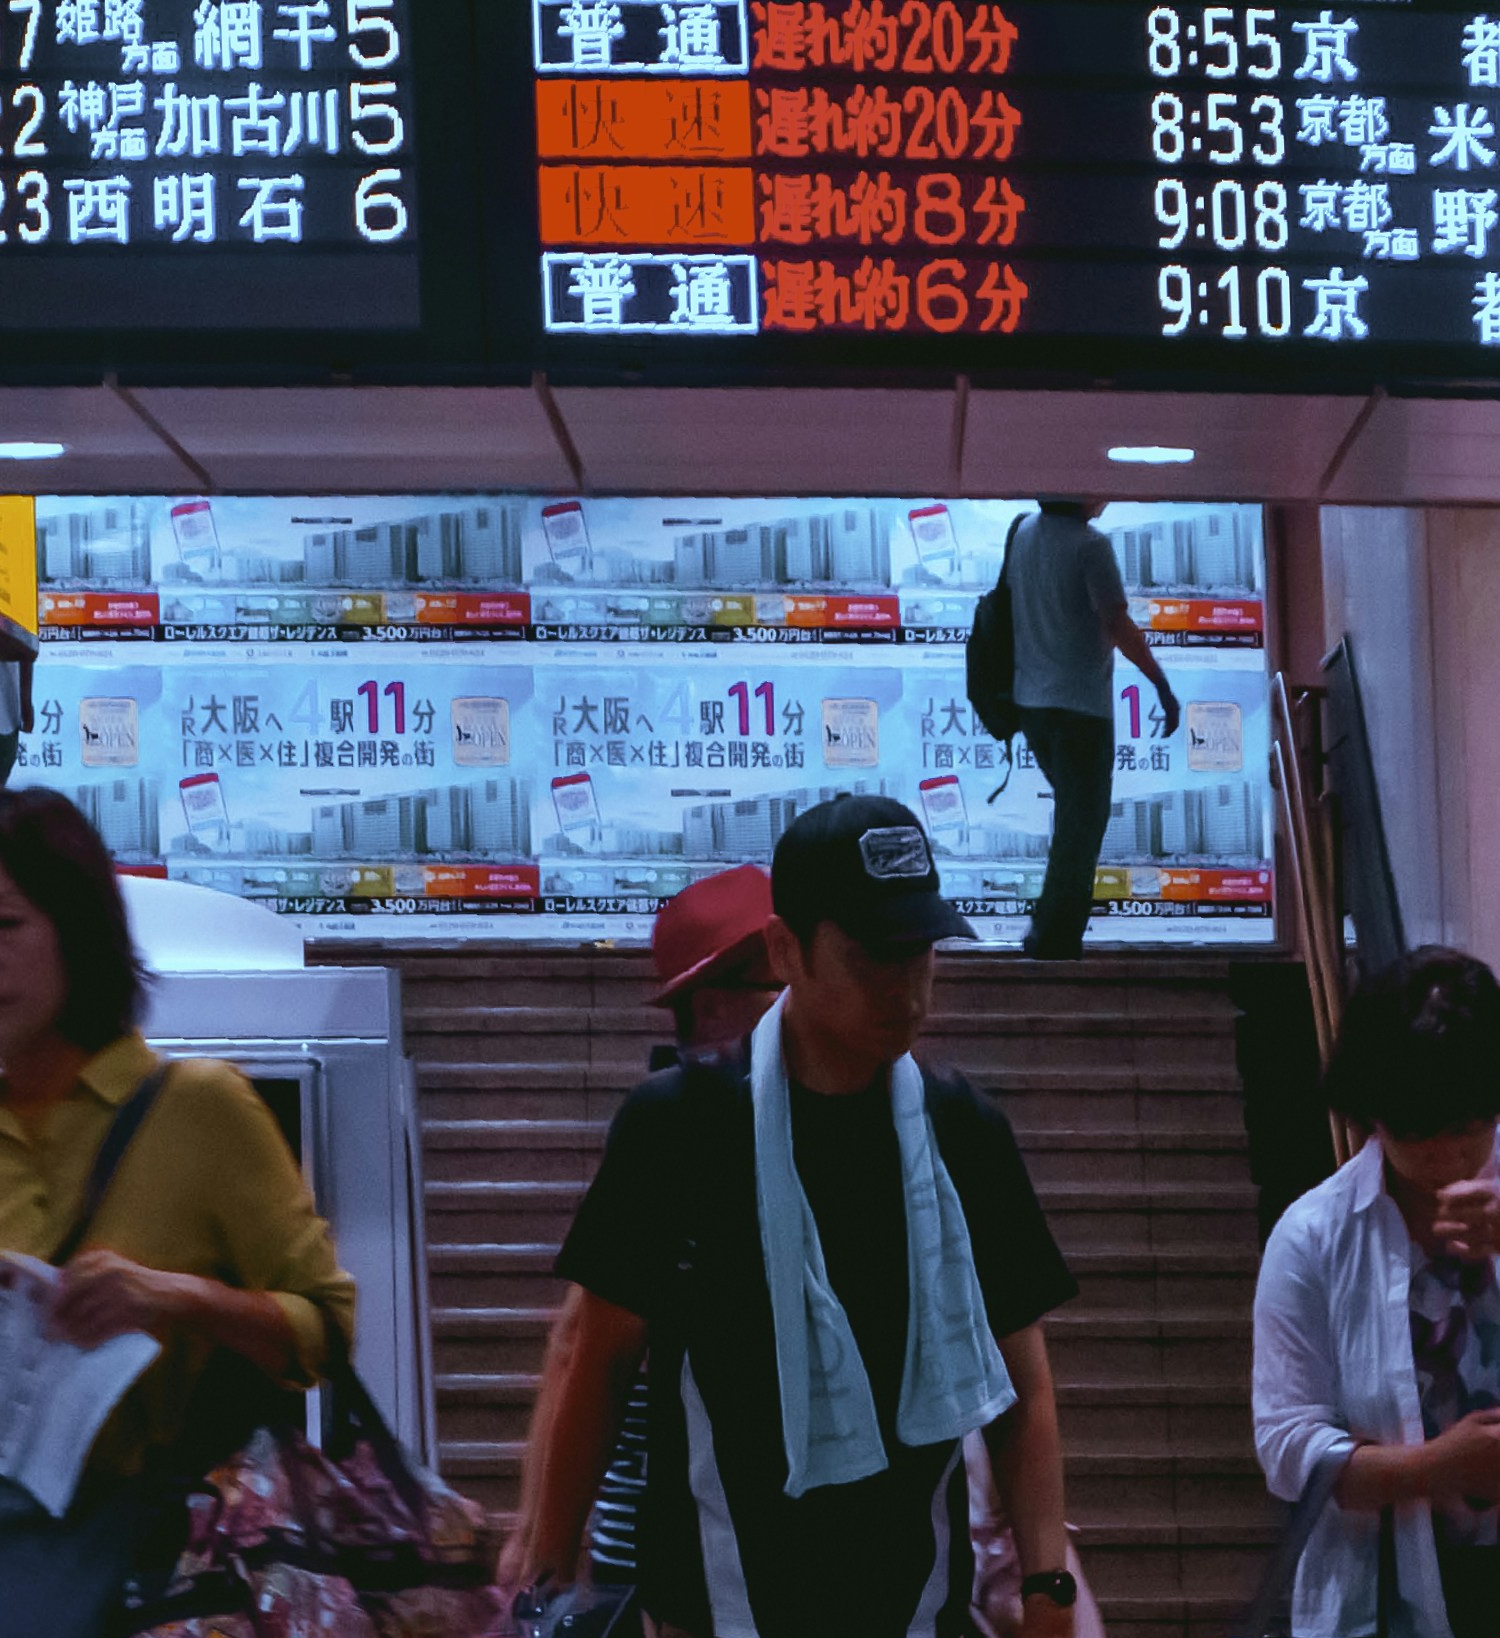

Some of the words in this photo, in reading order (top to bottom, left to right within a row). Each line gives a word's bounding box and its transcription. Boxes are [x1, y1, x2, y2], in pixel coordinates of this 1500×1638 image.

[346, 0, 400, 70] 5
[557, 2, 721, 67] 普通
[1147, 5, 1284, 79] 8:55
[350, 82, 404, 156] 5
[561, 86, 724, 153] 快速
[1151, 90, 1287, 167] 8:53
[63, 172, 305, 244] 西明石
[355, 169, 408, 243] 6
[564, 171, 726, 239] 快速
[1153, 177, 1290, 252] 9:08
[567, 261, 735, 328] 普通
[1157, 263, 1292, 338] 9:10
